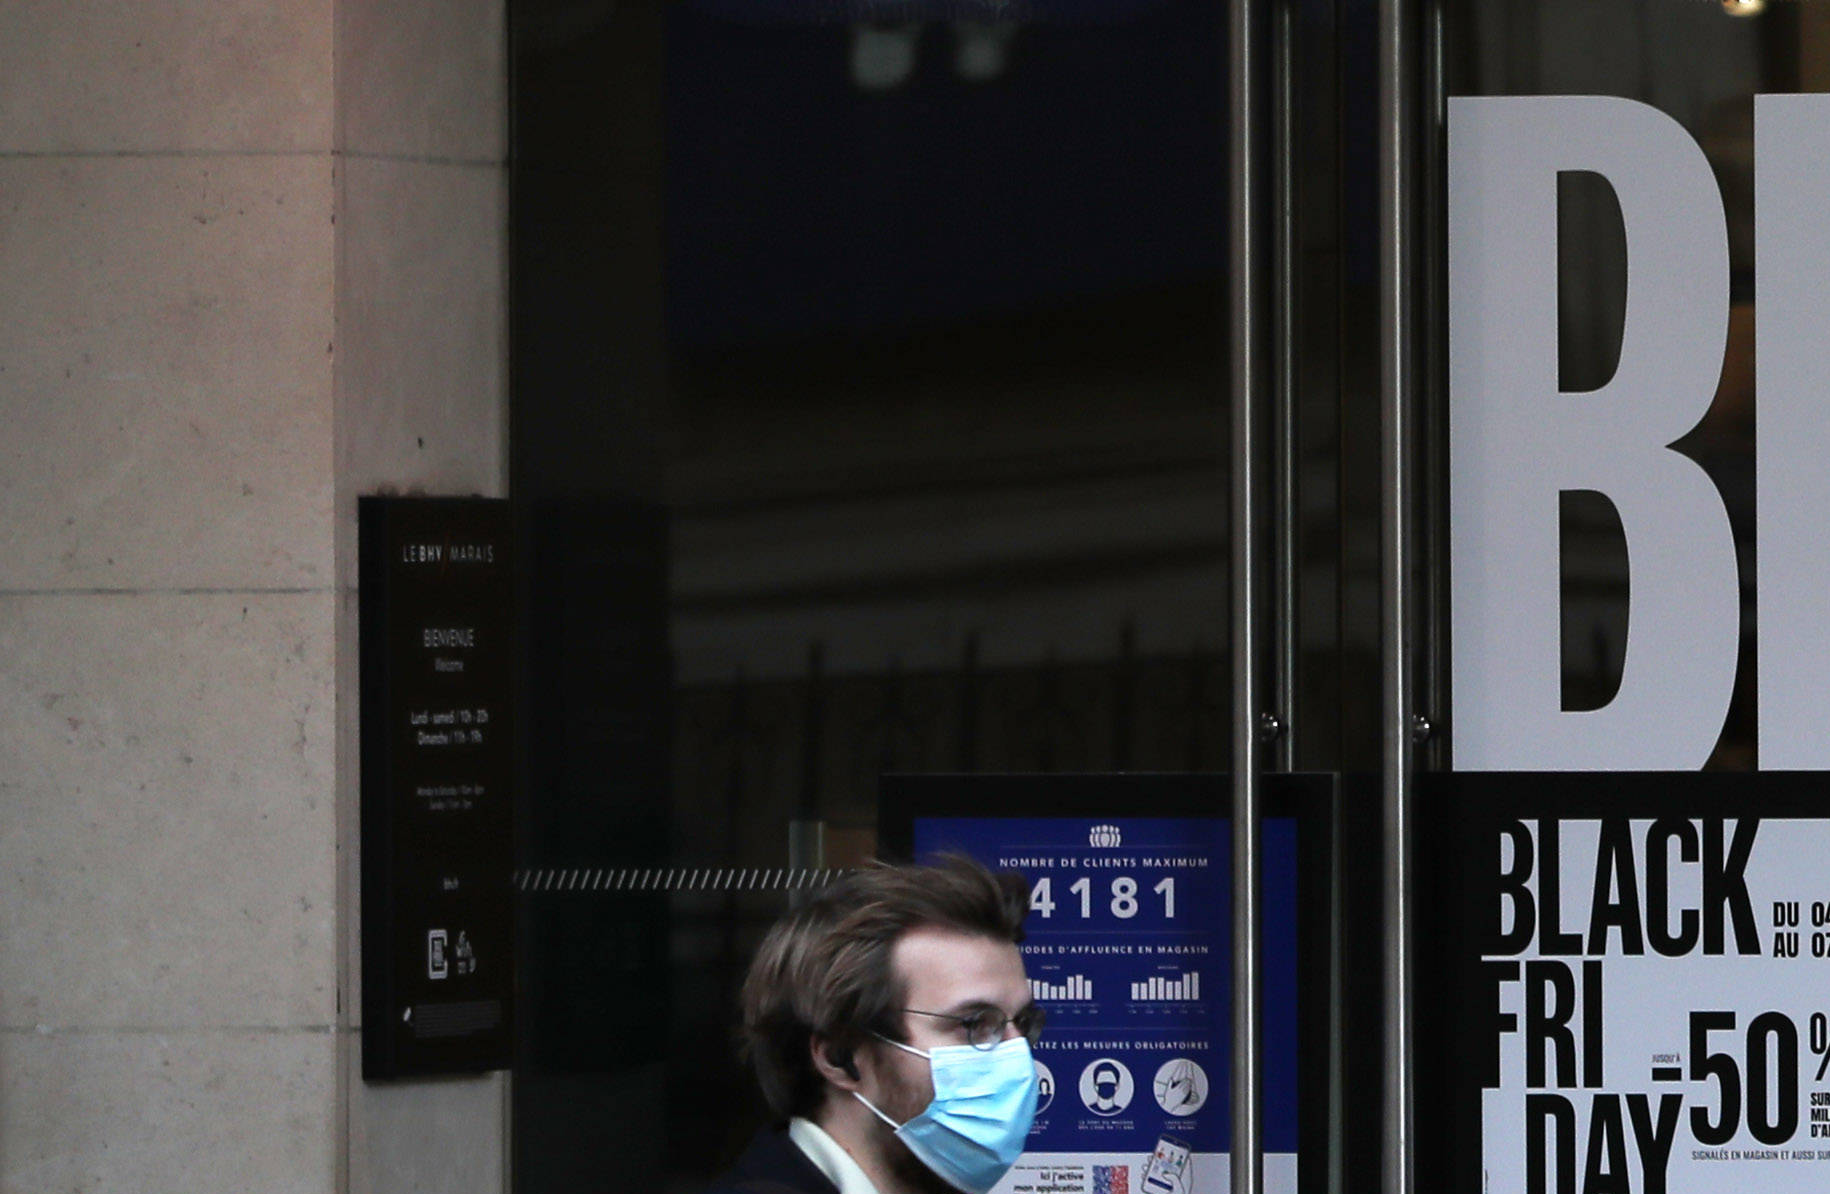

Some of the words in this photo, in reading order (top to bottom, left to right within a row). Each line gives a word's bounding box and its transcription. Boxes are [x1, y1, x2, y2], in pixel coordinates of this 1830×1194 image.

[402, 544, 416, 563] LE
[999, 858, 1055, 868] NOMBRE
[1061, 858, 1078, 868] DE
[1083, 858, 1137, 868] CLIENTS
[1143, 857, 1209, 868] MAXIMUM
[1480, 816, 1761, 957] BLACK
[1030, 876, 1177, 919] 4181
[1773, 901, 1800, 928] DU
[1058, 946, 1133, 954] D'AFFLUENCE
[1138, 946, 1153, 954] EN
[1157, 945, 1209, 954] MAGASIN
[1773, 932, 1800, 958] AU
[1480, 960, 1603, 1088] FRI
[1061, 1042, 1080, 1050] LES
[1083, 1041, 1131, 1050] MESURES
[1134, 1041, 1209, 1050] OBLIGATOIRES
[1691, 1149, 1729, 1161] SIGNALÉS
[1730, 1150, 1742, 1160] EN
[1743, 1150, 1779, 1160] MAGASIN
[1780, 1150, 1790, 1160] ET
[1792, 1150, 1816, 1160] AUSSI
[1036, 1184, 1084, 1194] application
